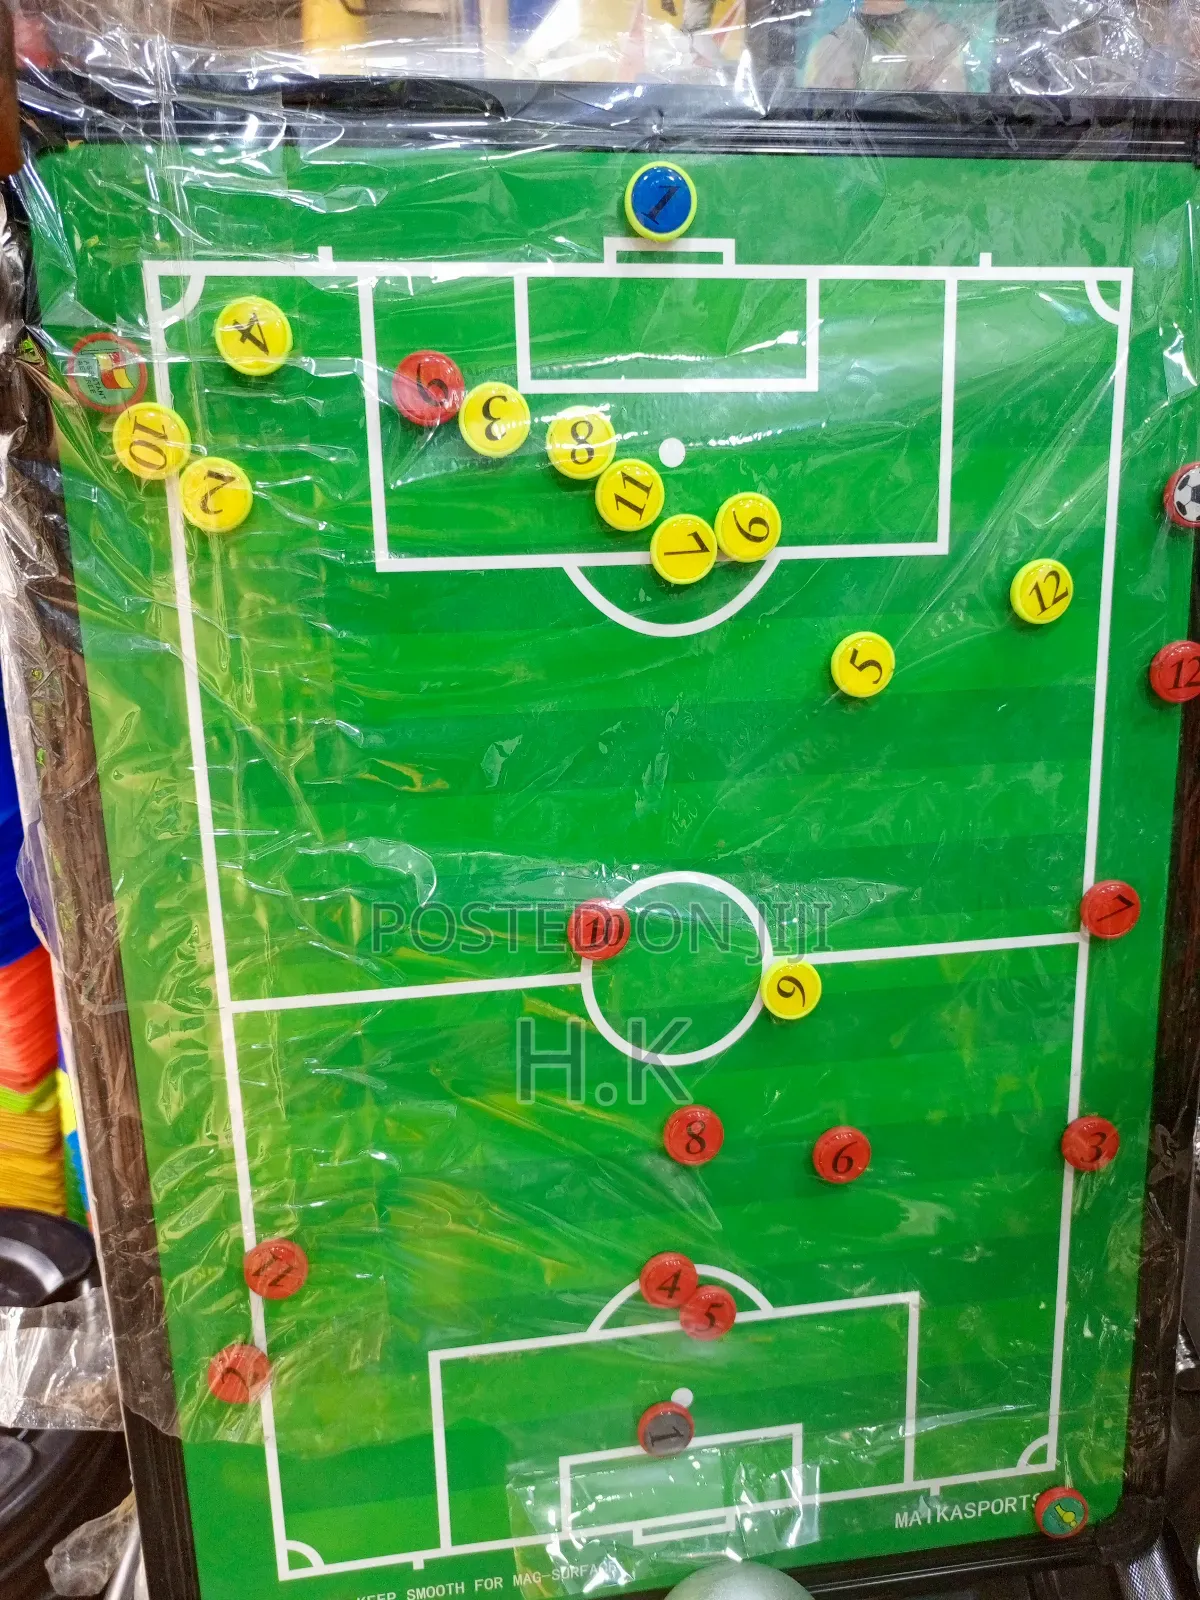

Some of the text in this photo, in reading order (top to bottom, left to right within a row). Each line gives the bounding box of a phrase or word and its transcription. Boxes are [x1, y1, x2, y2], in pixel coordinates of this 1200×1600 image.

[643, 185, 680, 224] 1
[233, 312, 269, 356] 4
[482, 395, 508, 441] 3
[128, 416, 169, 470] 10
[570, 420, 594, 465] 8
[614, 471, 654, 521] 11
[664, 531, 711, 557] 7
[1029, 570, 1069, 617] 12
[849, 648, 883, 685] 5
[1168, 655, 1200, 691] 12
[1097, 892, 1135, 923] 7
[584, 914, 624, 950] 10
[686, 1120, 706, 1155] 8
[1082, 1132, 1107, 1163] 3
[833, 1141, 857, 1174] 6
[657, 1268, 682, 1299] 4
[697, 1302, 724, 1331] 5
[406, 1581, 465, 1600] SMOOTH
[474, 1576, 503, 1591] FOR
